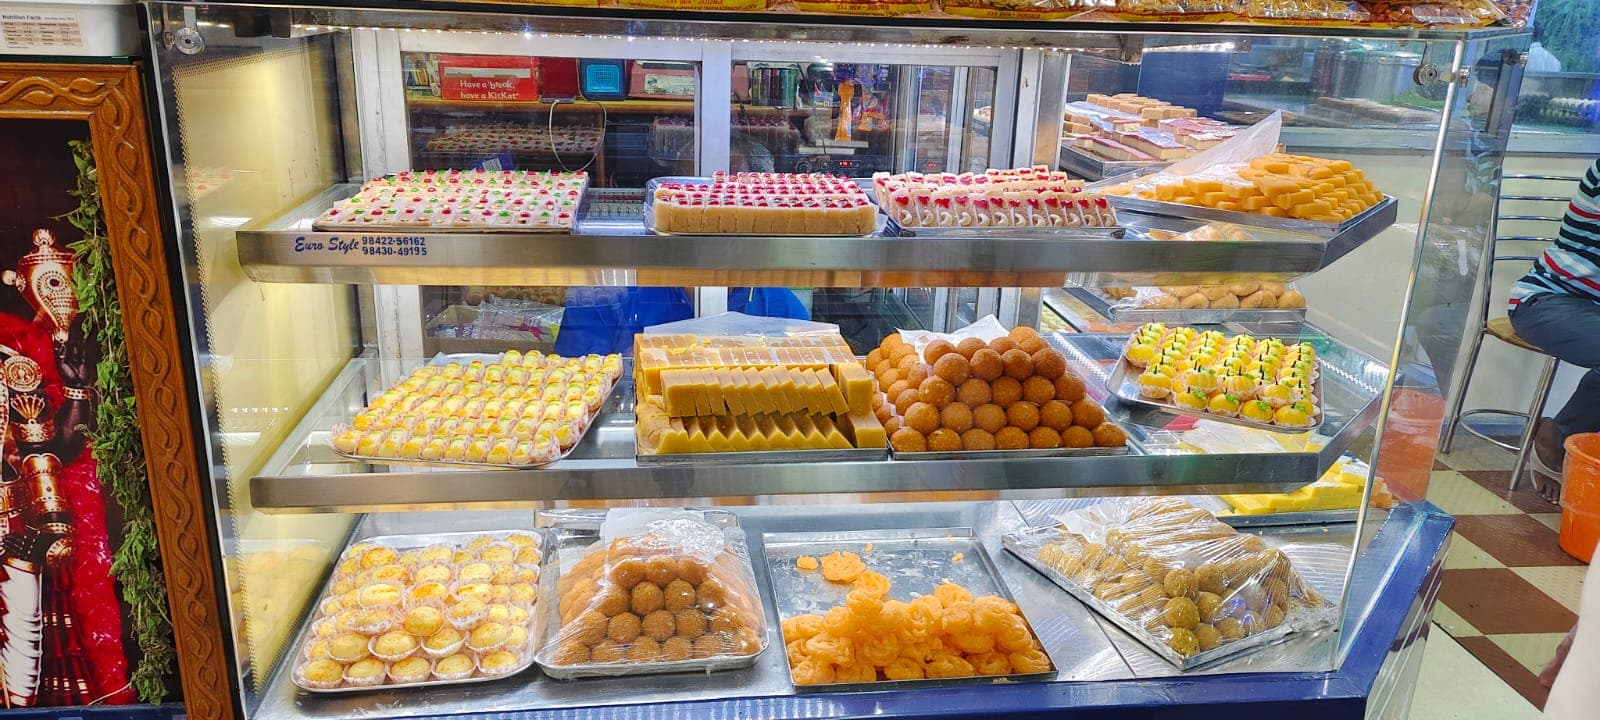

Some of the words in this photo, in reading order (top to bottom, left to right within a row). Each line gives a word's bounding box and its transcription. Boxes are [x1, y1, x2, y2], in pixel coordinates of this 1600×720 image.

[460, 80, 481, 88] Have
[460, 91, 480, 99] have
[294, 236, 325, 252] Euro
[328, 236, 360, 255] Style
[361, 236, 427, 247] 98422-56162
[361, 246, 428, 257] 98430-49195
